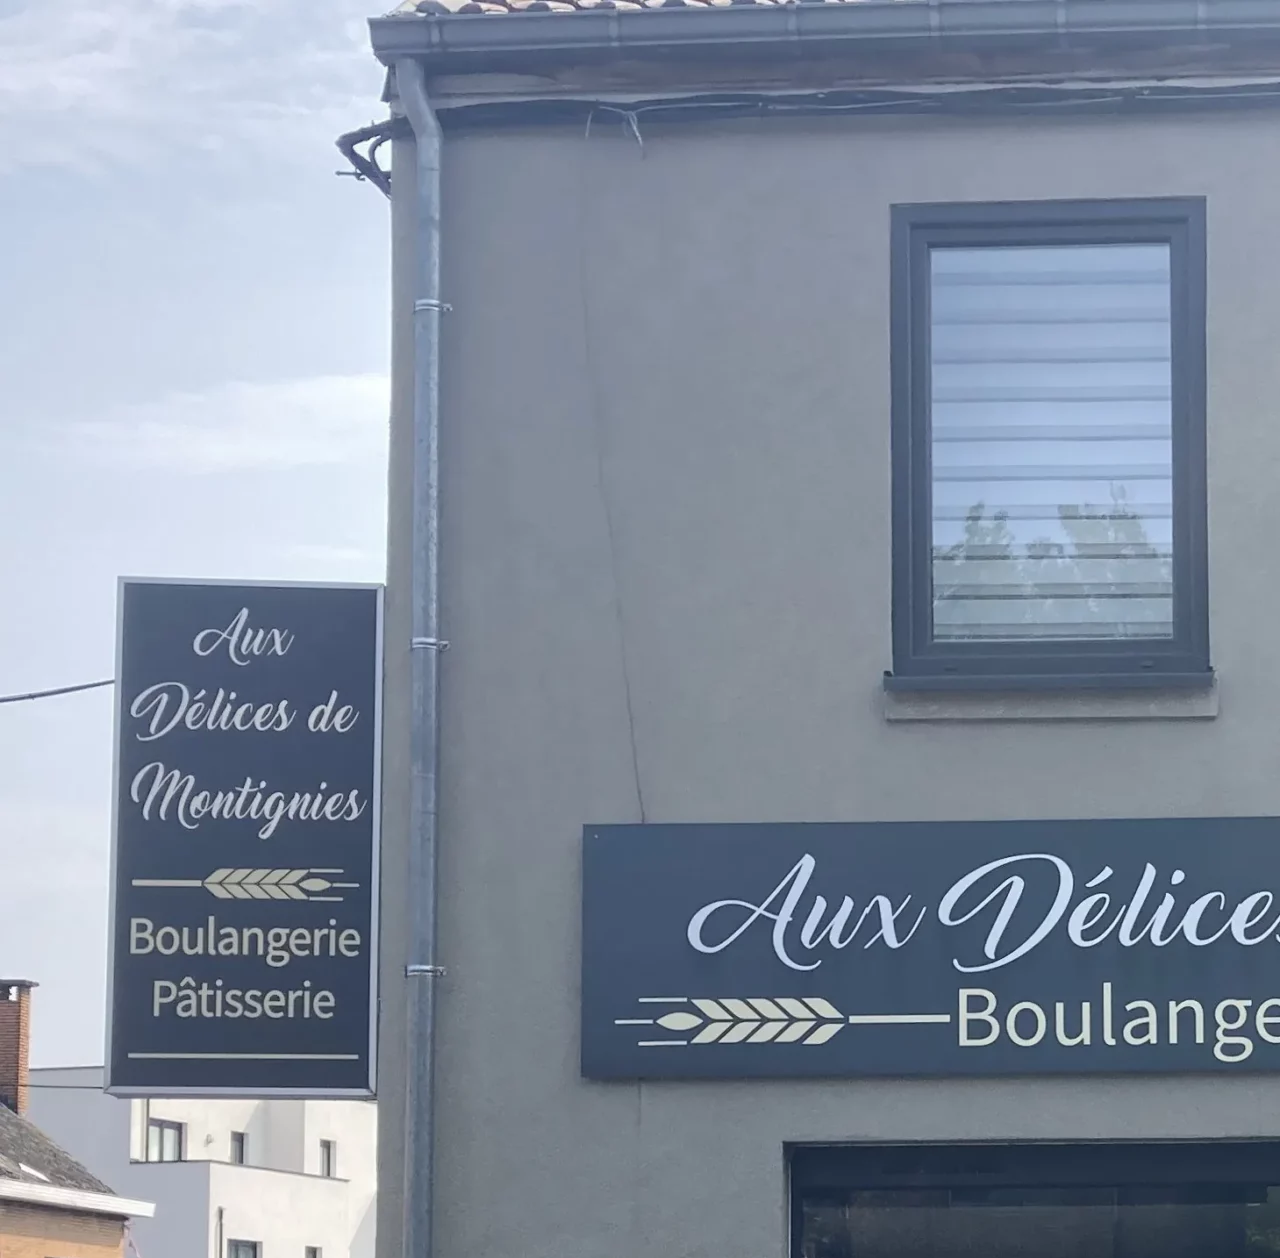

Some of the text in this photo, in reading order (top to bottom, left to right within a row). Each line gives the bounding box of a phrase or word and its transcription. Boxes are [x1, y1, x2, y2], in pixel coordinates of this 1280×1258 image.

[193, 606, 295, 666] Aux
[130, 681, 360, 742] Délices de
[130, 761, 368, 840] Montignies
[129, 915, 361, 967] Boulangerie
[687, 853, 927, 971] Aux
[152, 976, 335, 1019] Pâtisserie
